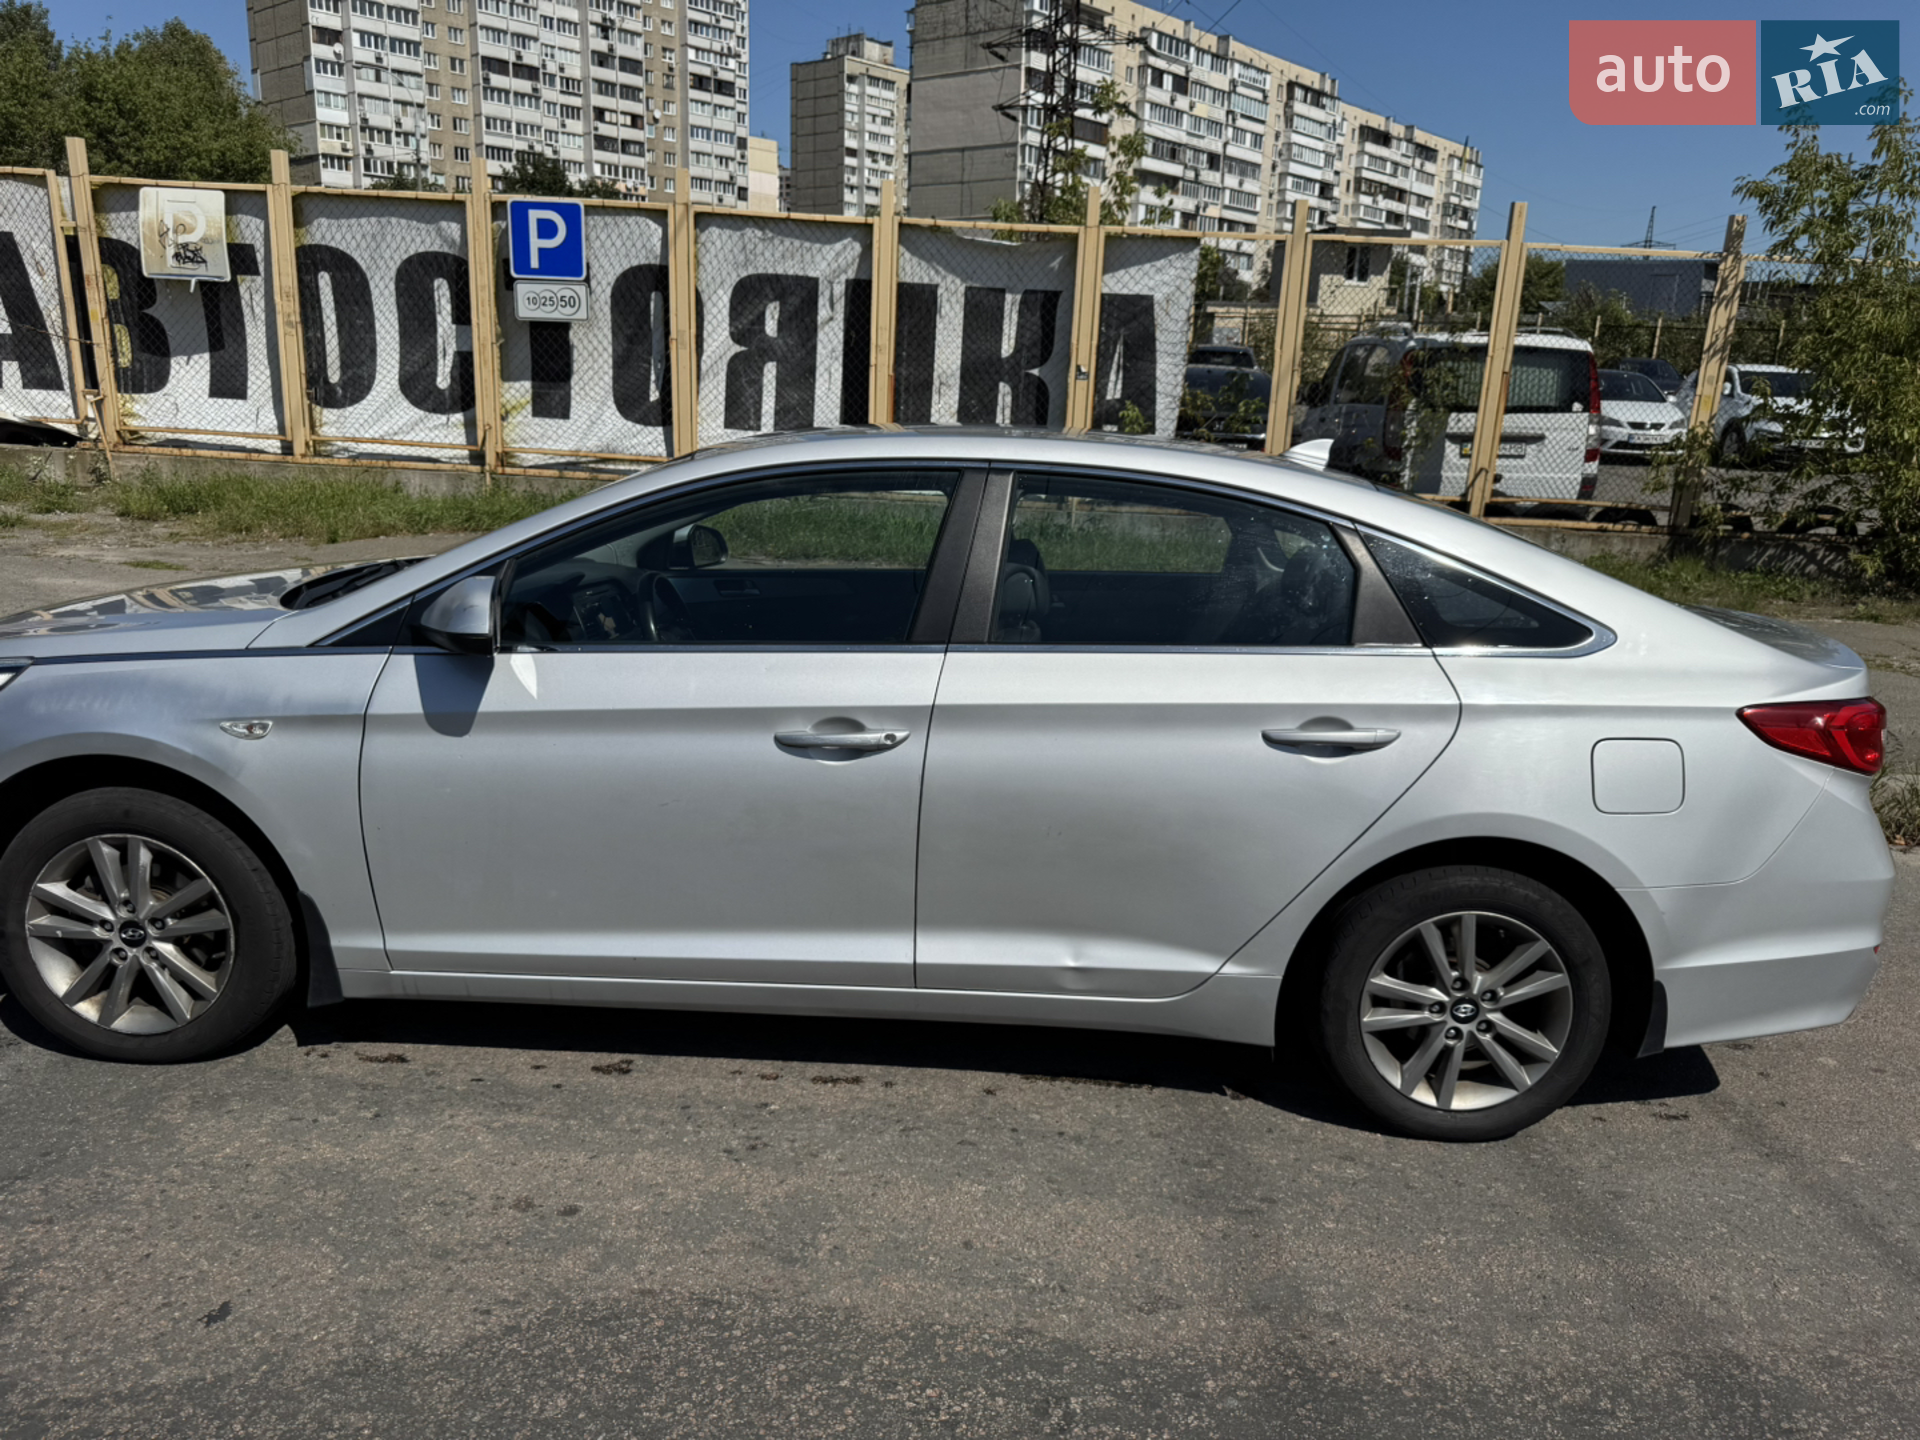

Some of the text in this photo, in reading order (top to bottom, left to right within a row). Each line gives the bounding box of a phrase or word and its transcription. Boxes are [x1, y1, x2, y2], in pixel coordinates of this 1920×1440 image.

[164, 202, 206, 268] P
[528, 208, 567, 269] P
[526, 295, 576, 308] 10 25 50
